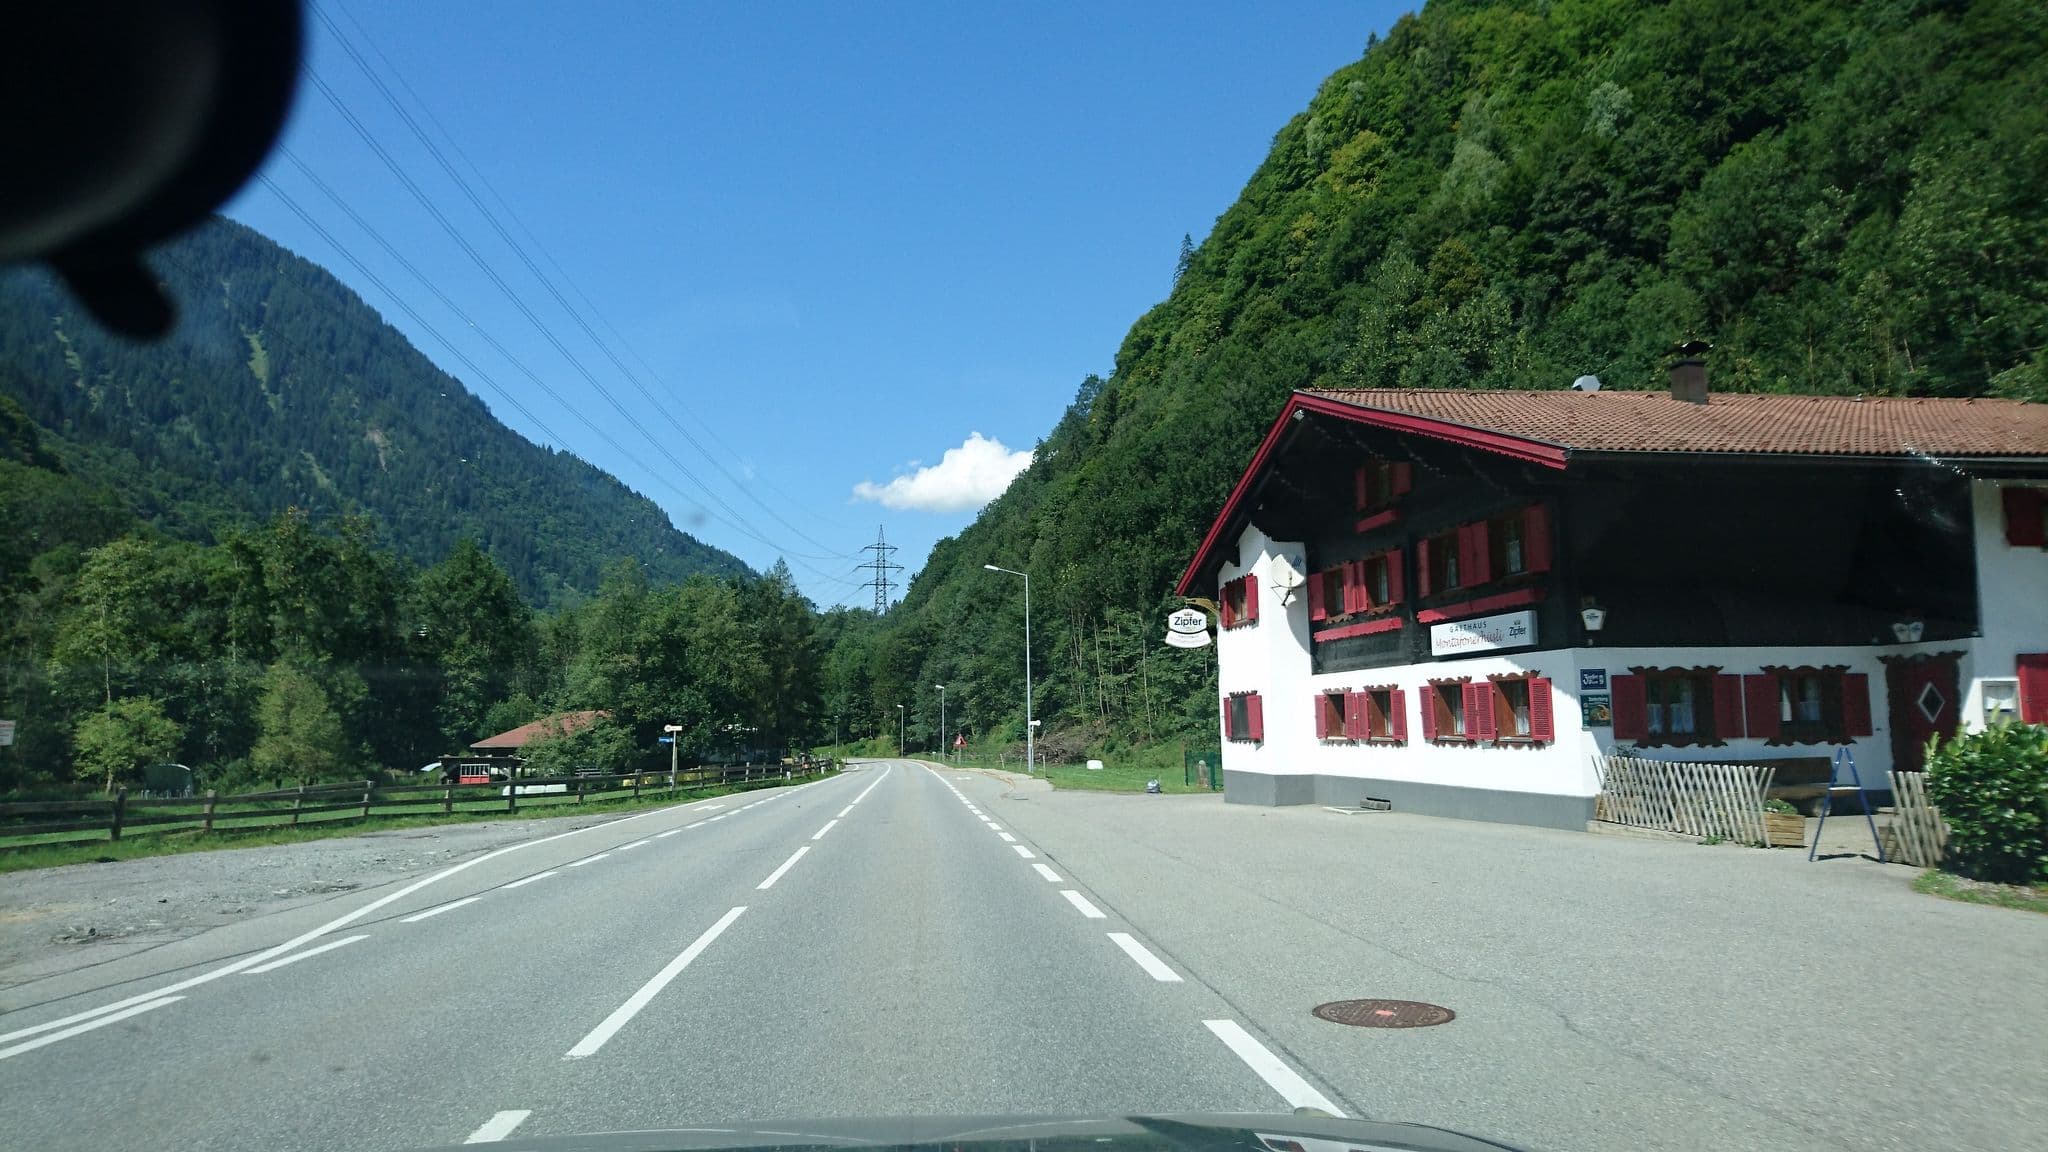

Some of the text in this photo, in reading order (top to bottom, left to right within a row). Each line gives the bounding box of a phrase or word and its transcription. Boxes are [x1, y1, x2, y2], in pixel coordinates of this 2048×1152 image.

[1174, 616, 1202, 627] Zipfer
[1449, 621, 1487, 633] GASTHAUS
[1509, 626, 1527, 638] Zipfer
